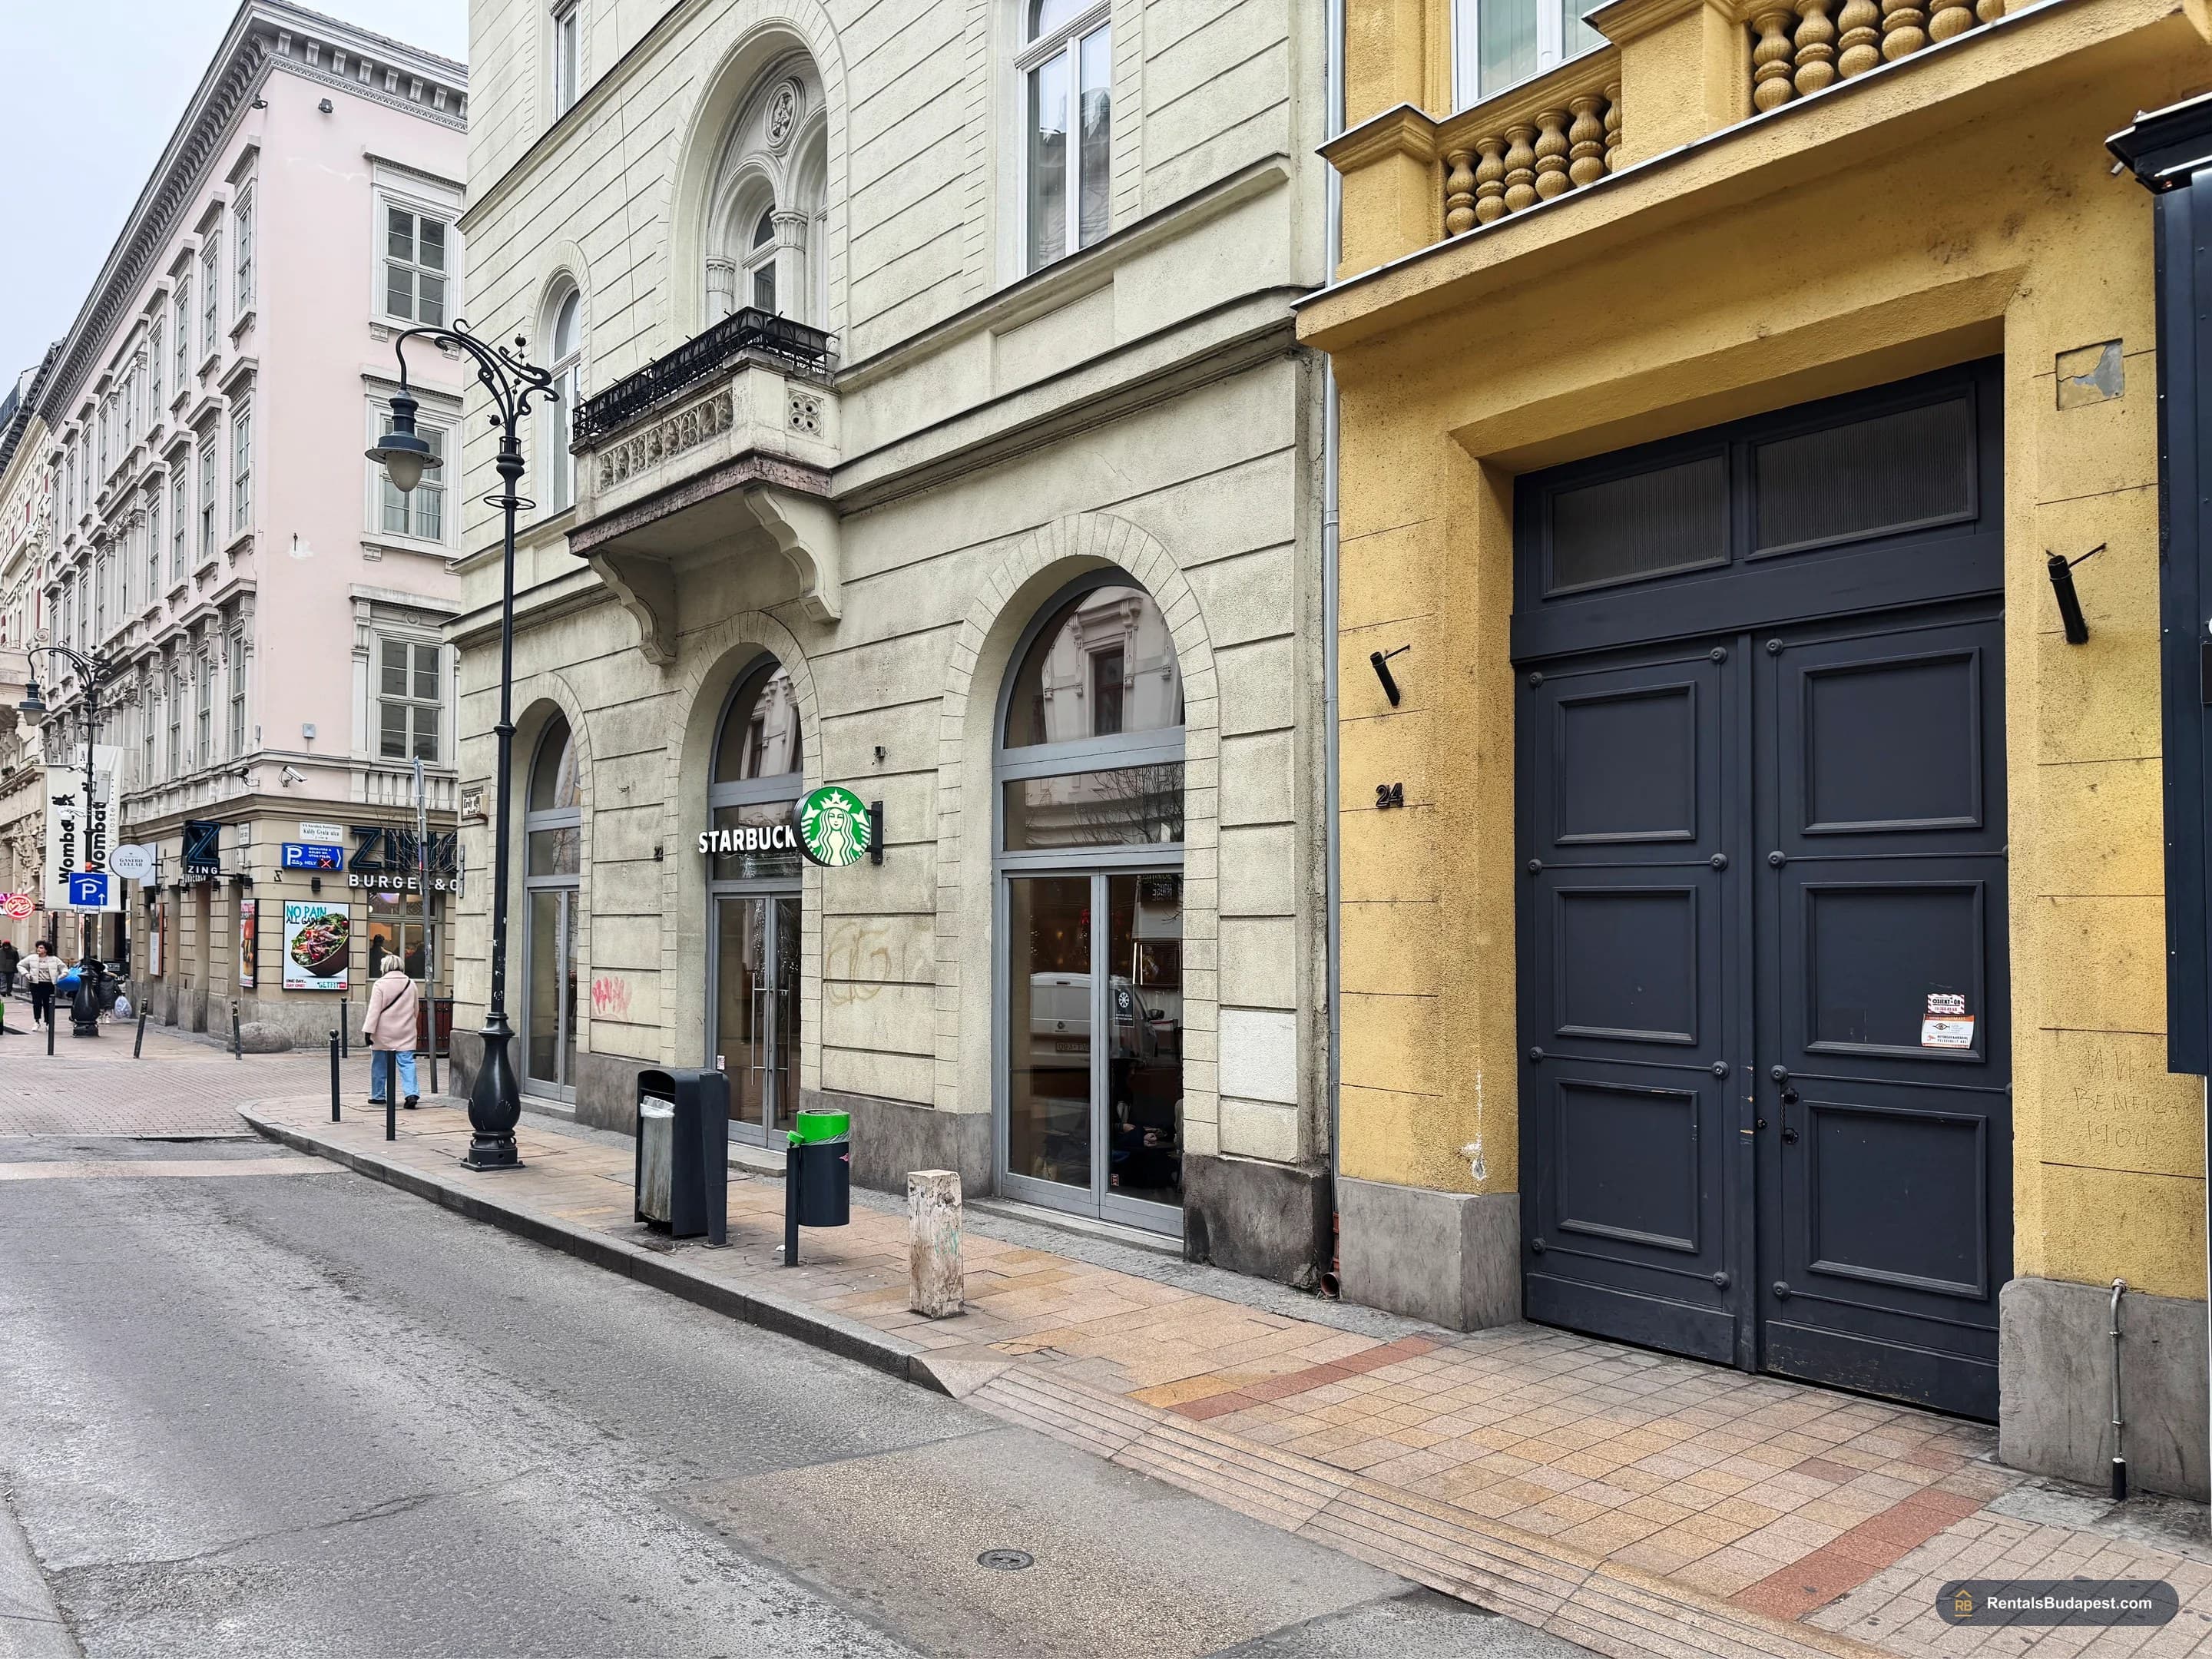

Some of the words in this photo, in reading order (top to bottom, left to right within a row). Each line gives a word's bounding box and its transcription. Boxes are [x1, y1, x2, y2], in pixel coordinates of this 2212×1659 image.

[1376, 783, 1403, 807] 24
[698, 825, 797, 853] STARBUCK
[286, 847, 303, 866] P
[187, 866, 218, 875] ZING
[81, 883, 97, 900] P
[286, 905, 301, 917] NO
[304, 906, 326, 919] PAIN
[286, 916, 300, 924] ALL
[2087, 1121, 2148, 1149] 1904
